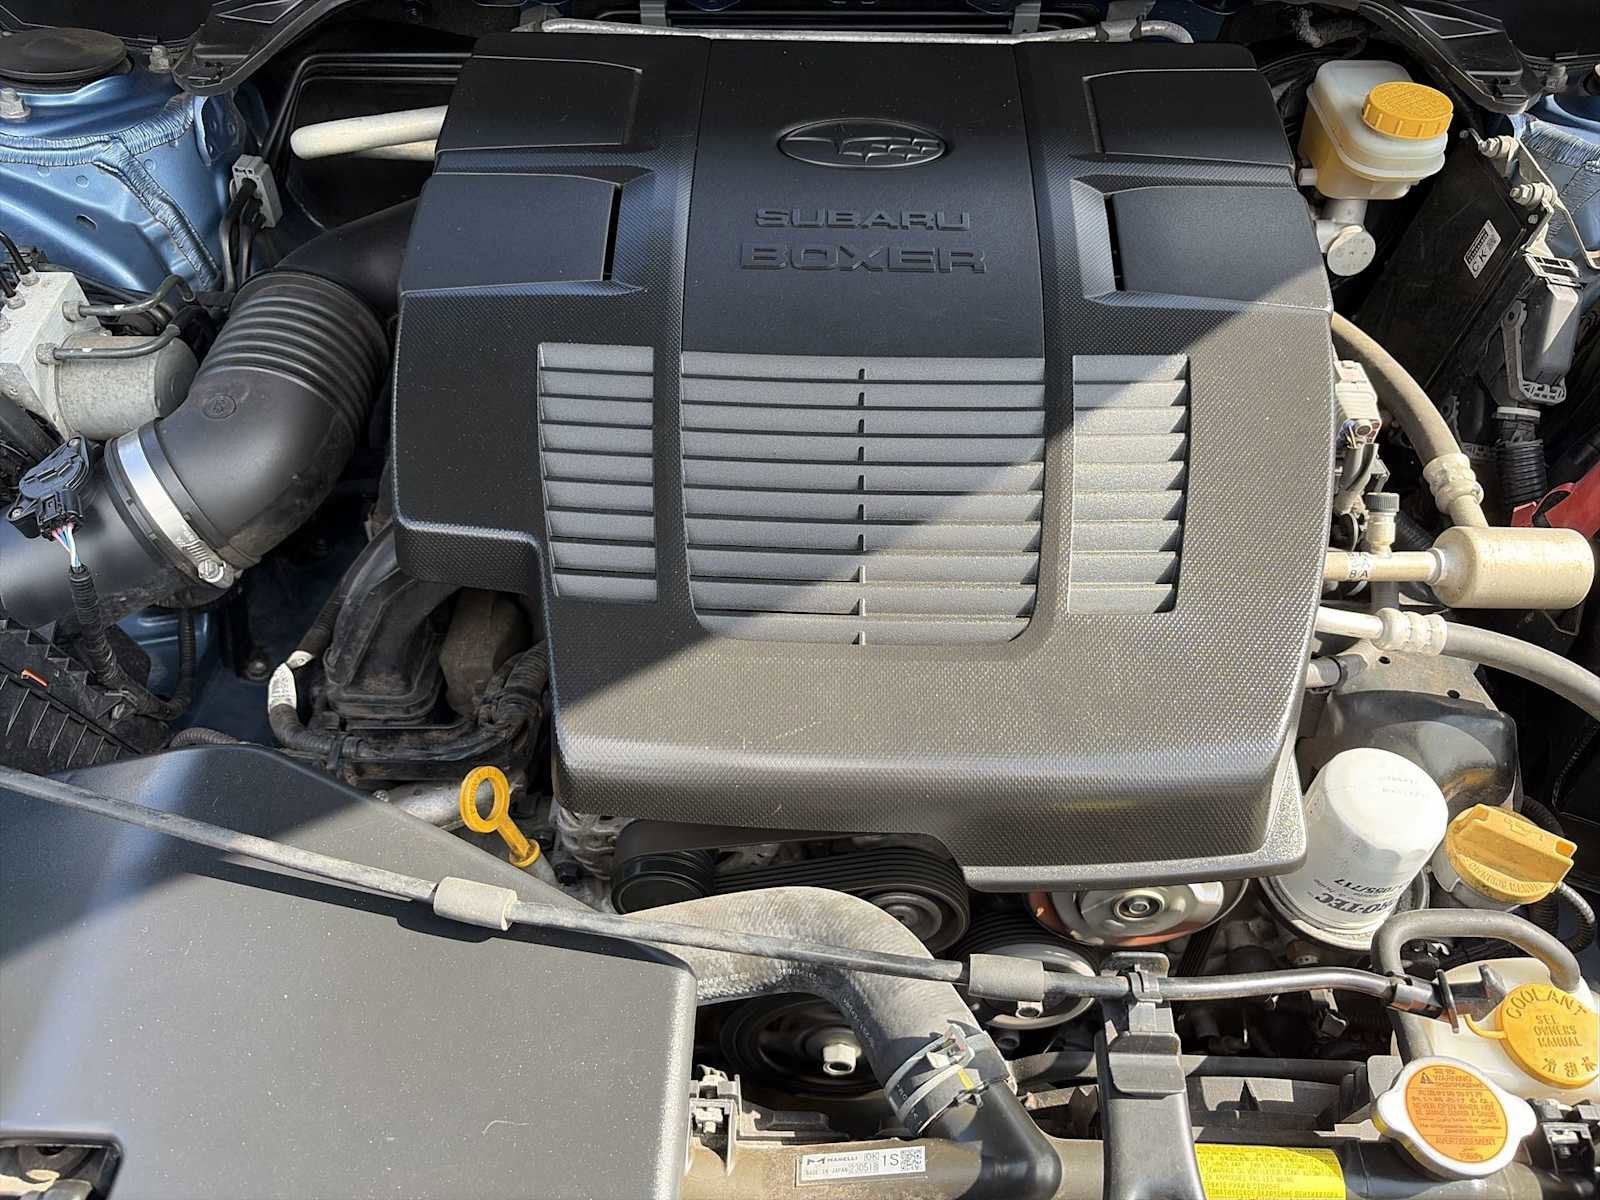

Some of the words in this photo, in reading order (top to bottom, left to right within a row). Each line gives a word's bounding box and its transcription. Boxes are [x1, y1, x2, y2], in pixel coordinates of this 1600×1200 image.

[756, 207, 970, 231] SUBARU
[740, 241, 987, 273] BOXER
[1506, 987, 1588, 1019] COOLANT
[1533, 1024, 1577, 1037] OWNERS
[1537, 1035, 1583, 1048] MANUAL
